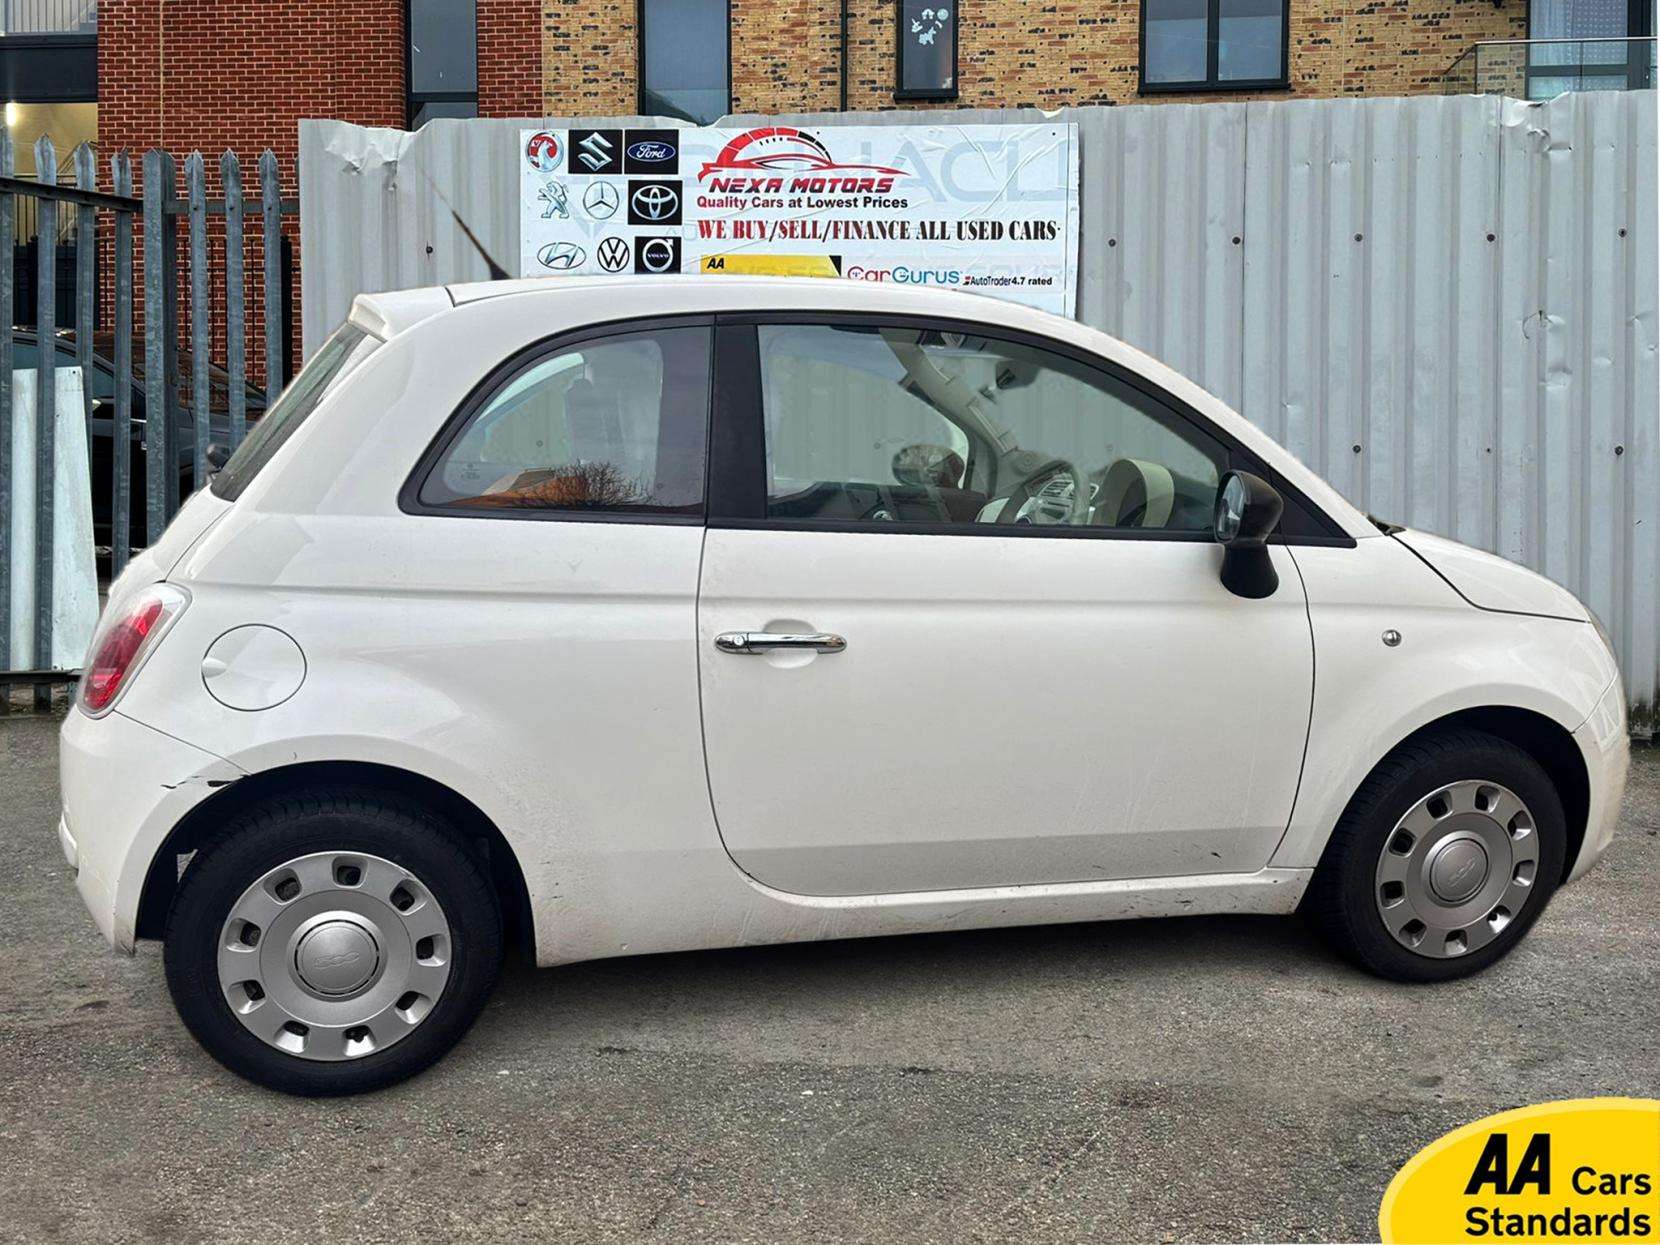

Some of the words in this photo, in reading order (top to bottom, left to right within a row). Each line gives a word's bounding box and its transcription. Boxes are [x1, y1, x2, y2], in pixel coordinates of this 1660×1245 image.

[636, 143, 667, 159] Ford
[708, 177, 781, 194] NEXA
[788, 177, 895, 194] MOTORS
[697, 195, 748, 211] Quality
[751, 196, 784, 209] Cars
[788, 196, 803, 209] at
[806, 196, 859, 209] Lowest
[862, 195, 909, 209] Prices
[697, 219, 727, 240] WE
[733, 219, 911, 243] BUY/SELL/FINANCE
[915, 220, 951, 241] ALL
[956, 220, 1004, 241] USED
[1008, 220, 1057, 241] CARS
[706, 257, 726, 270] AA
[847, 265, 960, 285] CarGurus
[1027, 276, 1053, 286] rated
